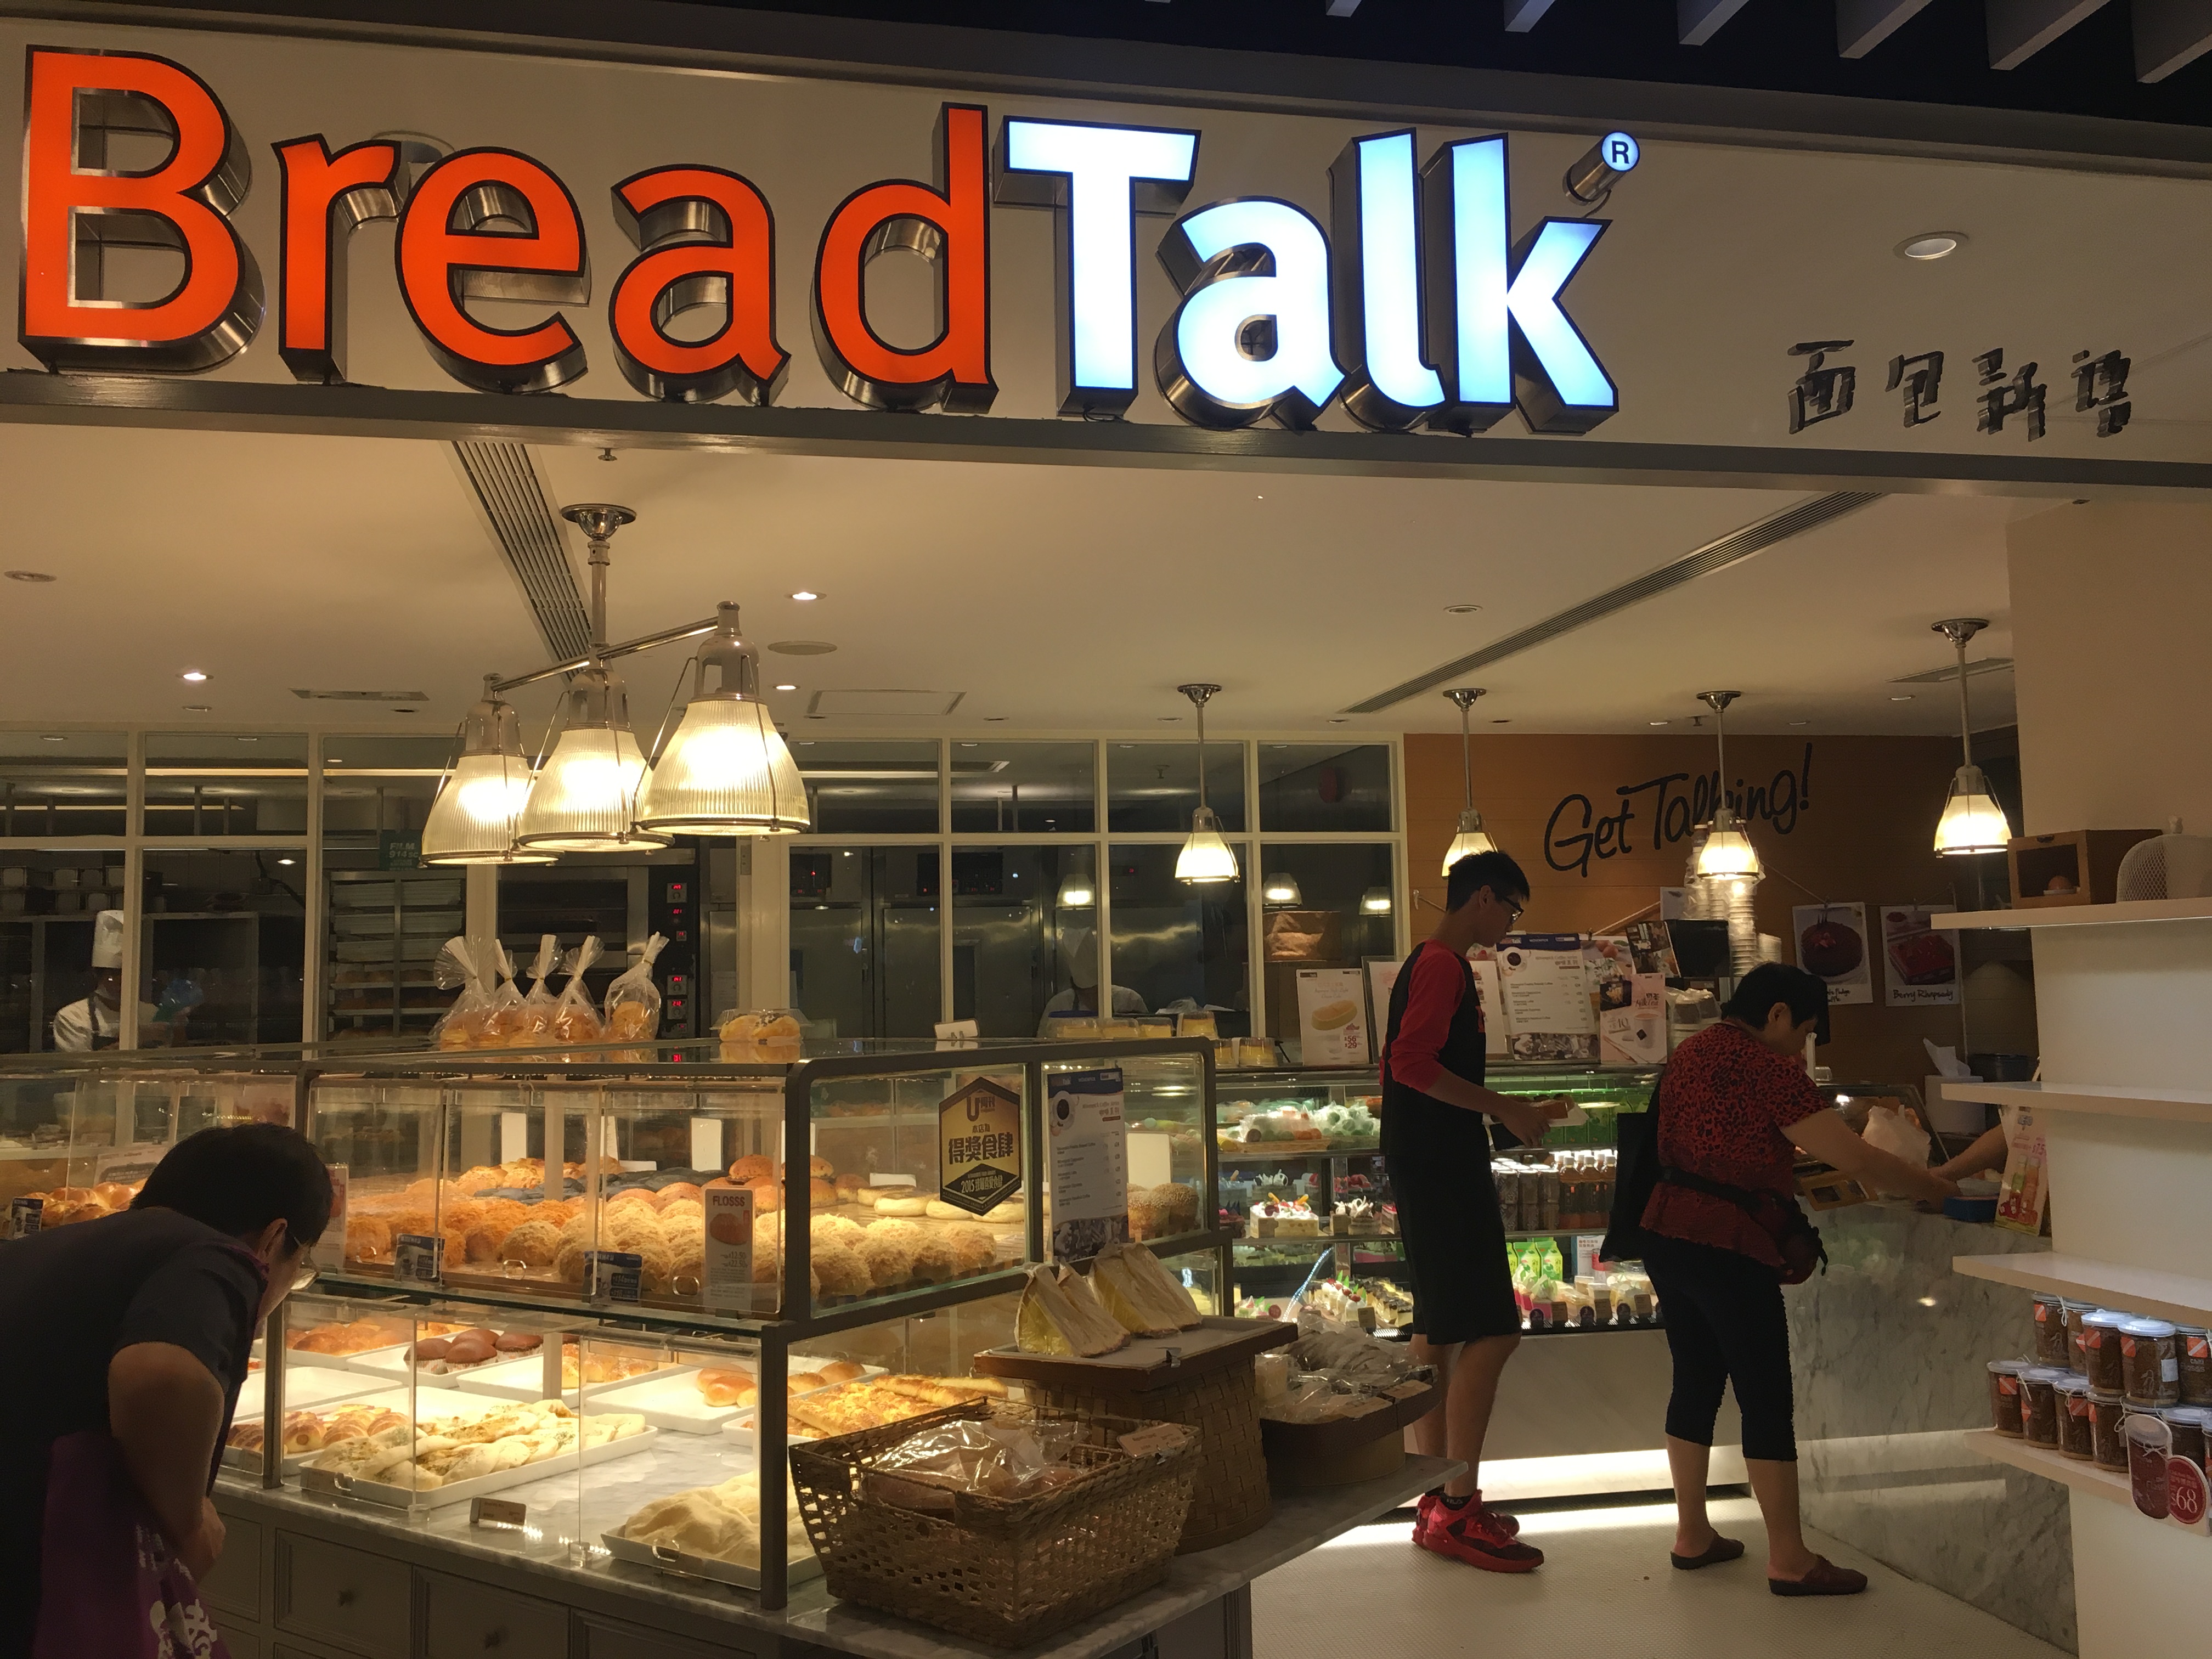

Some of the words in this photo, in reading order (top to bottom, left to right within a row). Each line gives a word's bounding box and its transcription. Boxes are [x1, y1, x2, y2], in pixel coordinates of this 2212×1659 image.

[1544, 794, 1635, 878] Get
[1893, 989, 1916, 1002] Berry
[1917, 989, 1953, 1001] Rhapsody
[948, 1132, 1014, 1165] 得獎食肆
[961, 1179, 975, 1193] 2015
[713, 1195, 745, 1207] FLOSSS
